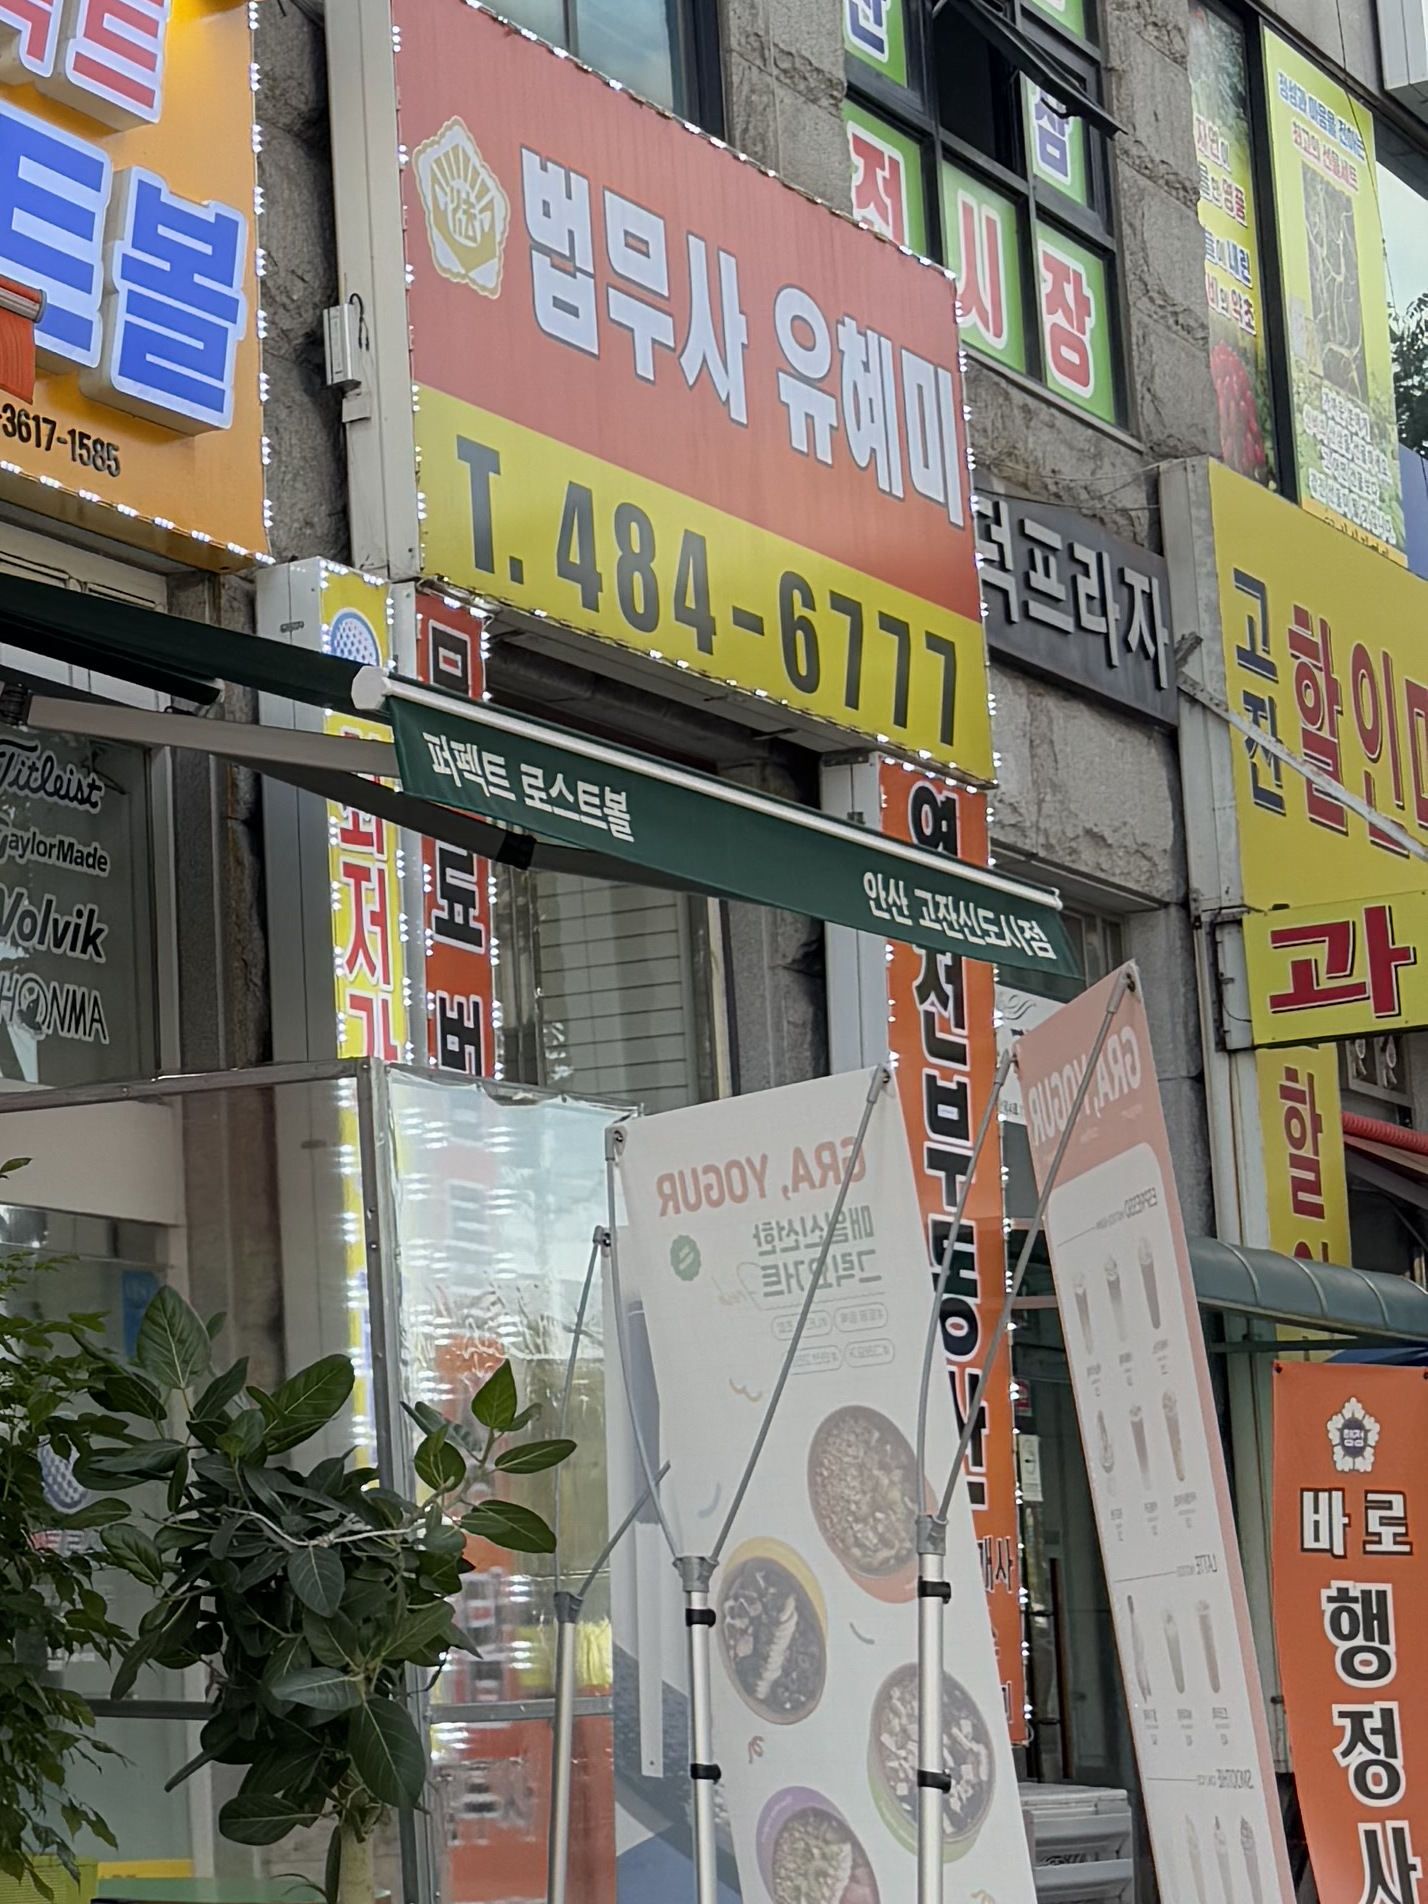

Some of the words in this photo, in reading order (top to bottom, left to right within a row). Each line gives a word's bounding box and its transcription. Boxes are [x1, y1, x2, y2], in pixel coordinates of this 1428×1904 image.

[523, 146, 748, 426] 법무사
[774, 286, 965, 528] 유혜미
[424, 733, 516, 802] 퍼펙트
[521, 761, 634, 843] 로스트볼
[864, 871, 910, 925] 안산
[914, 887, 1057, 960] 고잔신도시점
